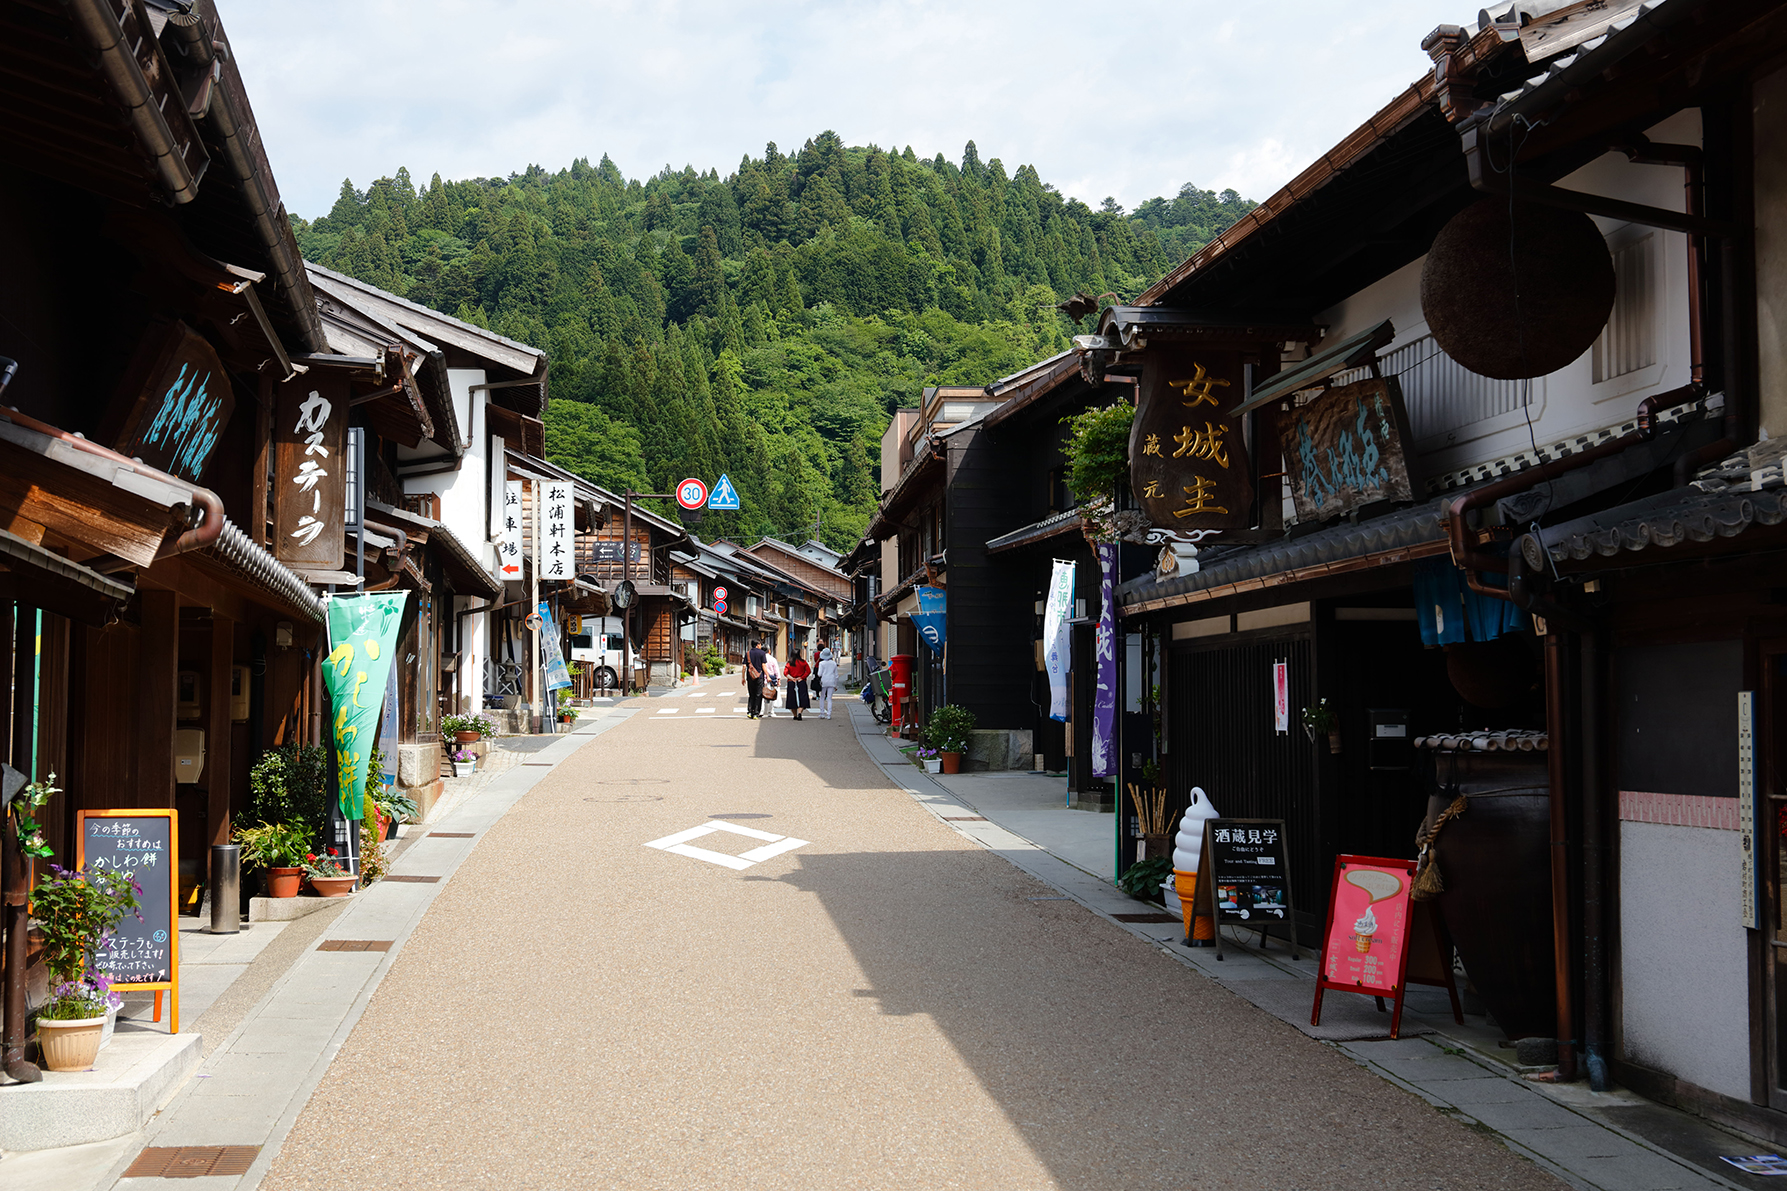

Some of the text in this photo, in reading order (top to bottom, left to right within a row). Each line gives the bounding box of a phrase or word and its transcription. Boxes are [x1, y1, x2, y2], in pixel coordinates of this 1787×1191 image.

[1169, 361, 1232, 520] 女城主
[290, 389, 333, 548] カステーラ
[1142, 433, 1165, 500] 蔵元
[684, 487, 700, 501] 30
[502, 491, 519, 558] 駐車場
[548, 485, 567, 577] 松浦軒本店
[329, 638, 381, 812] かしわ餅
[89, 822, 139, 836] 今の季節の
[1213, 828, 1278, 845] 酒蔵見学
[116, 838, 162, 849] おすすめは
[1231, 845, 1265, 853] ご自由にどうぞ
[94, 852, 157, 868] かしわ餅
[1389, 902, 1403, 962] 店内にて販売中
[1328, 954, 1338, 979] 女城主
[1364, 955, 1378, 966] 300
[1363, 965, 1377, 975] 200
[1363, 974, 1376, 985] 100
